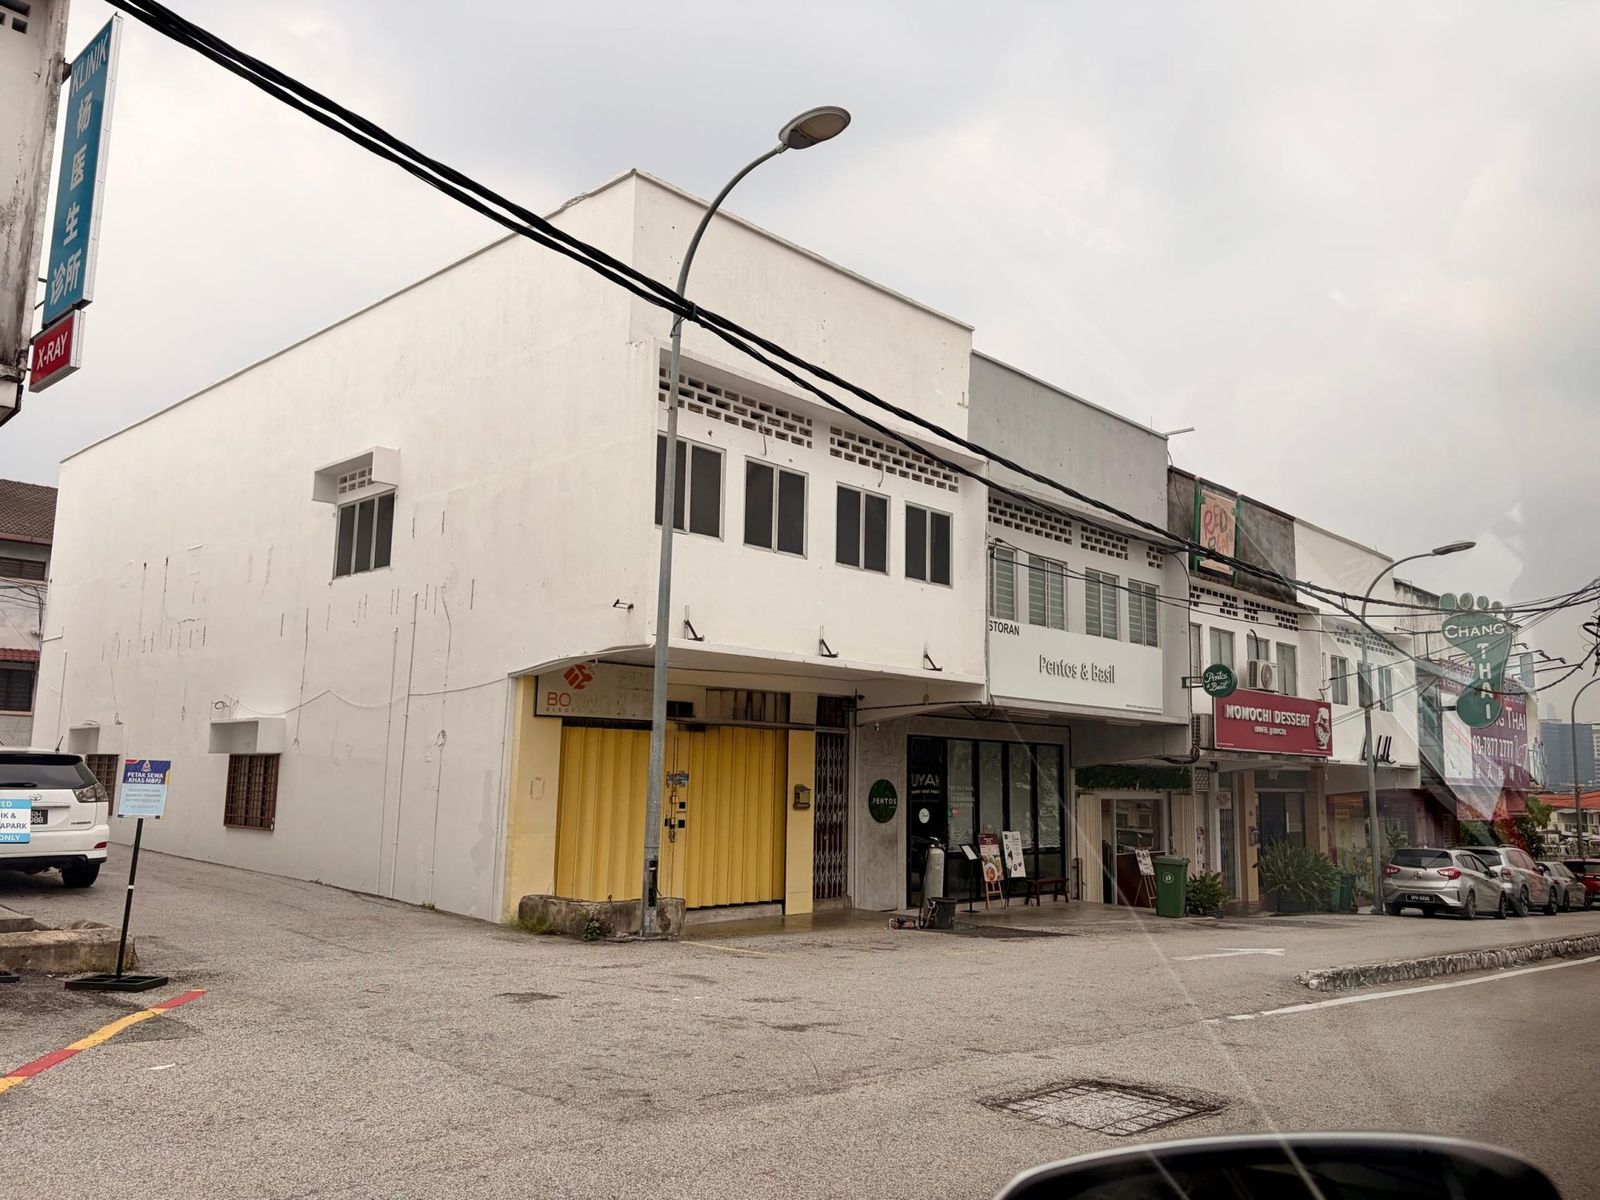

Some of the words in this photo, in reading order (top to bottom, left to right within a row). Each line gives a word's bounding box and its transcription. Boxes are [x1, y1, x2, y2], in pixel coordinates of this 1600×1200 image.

[71, 32, 109, 98] KLINIK
[50, 90, 94, 306] 杨医生诊所
[36, 330, 69, 370] X-RAY
[1444, 623, 1505, 638] CHANG
[1039, 654, 1078, 679] Pentos
[1080, 664, 1089, 680] &
[1091, 663, 1115, 683] Basil
[1476, 642, 1494, 720] THAI
[1273, 710, 1311, 727] DESSERT
[1505, 706, 1526, 731] THAI
